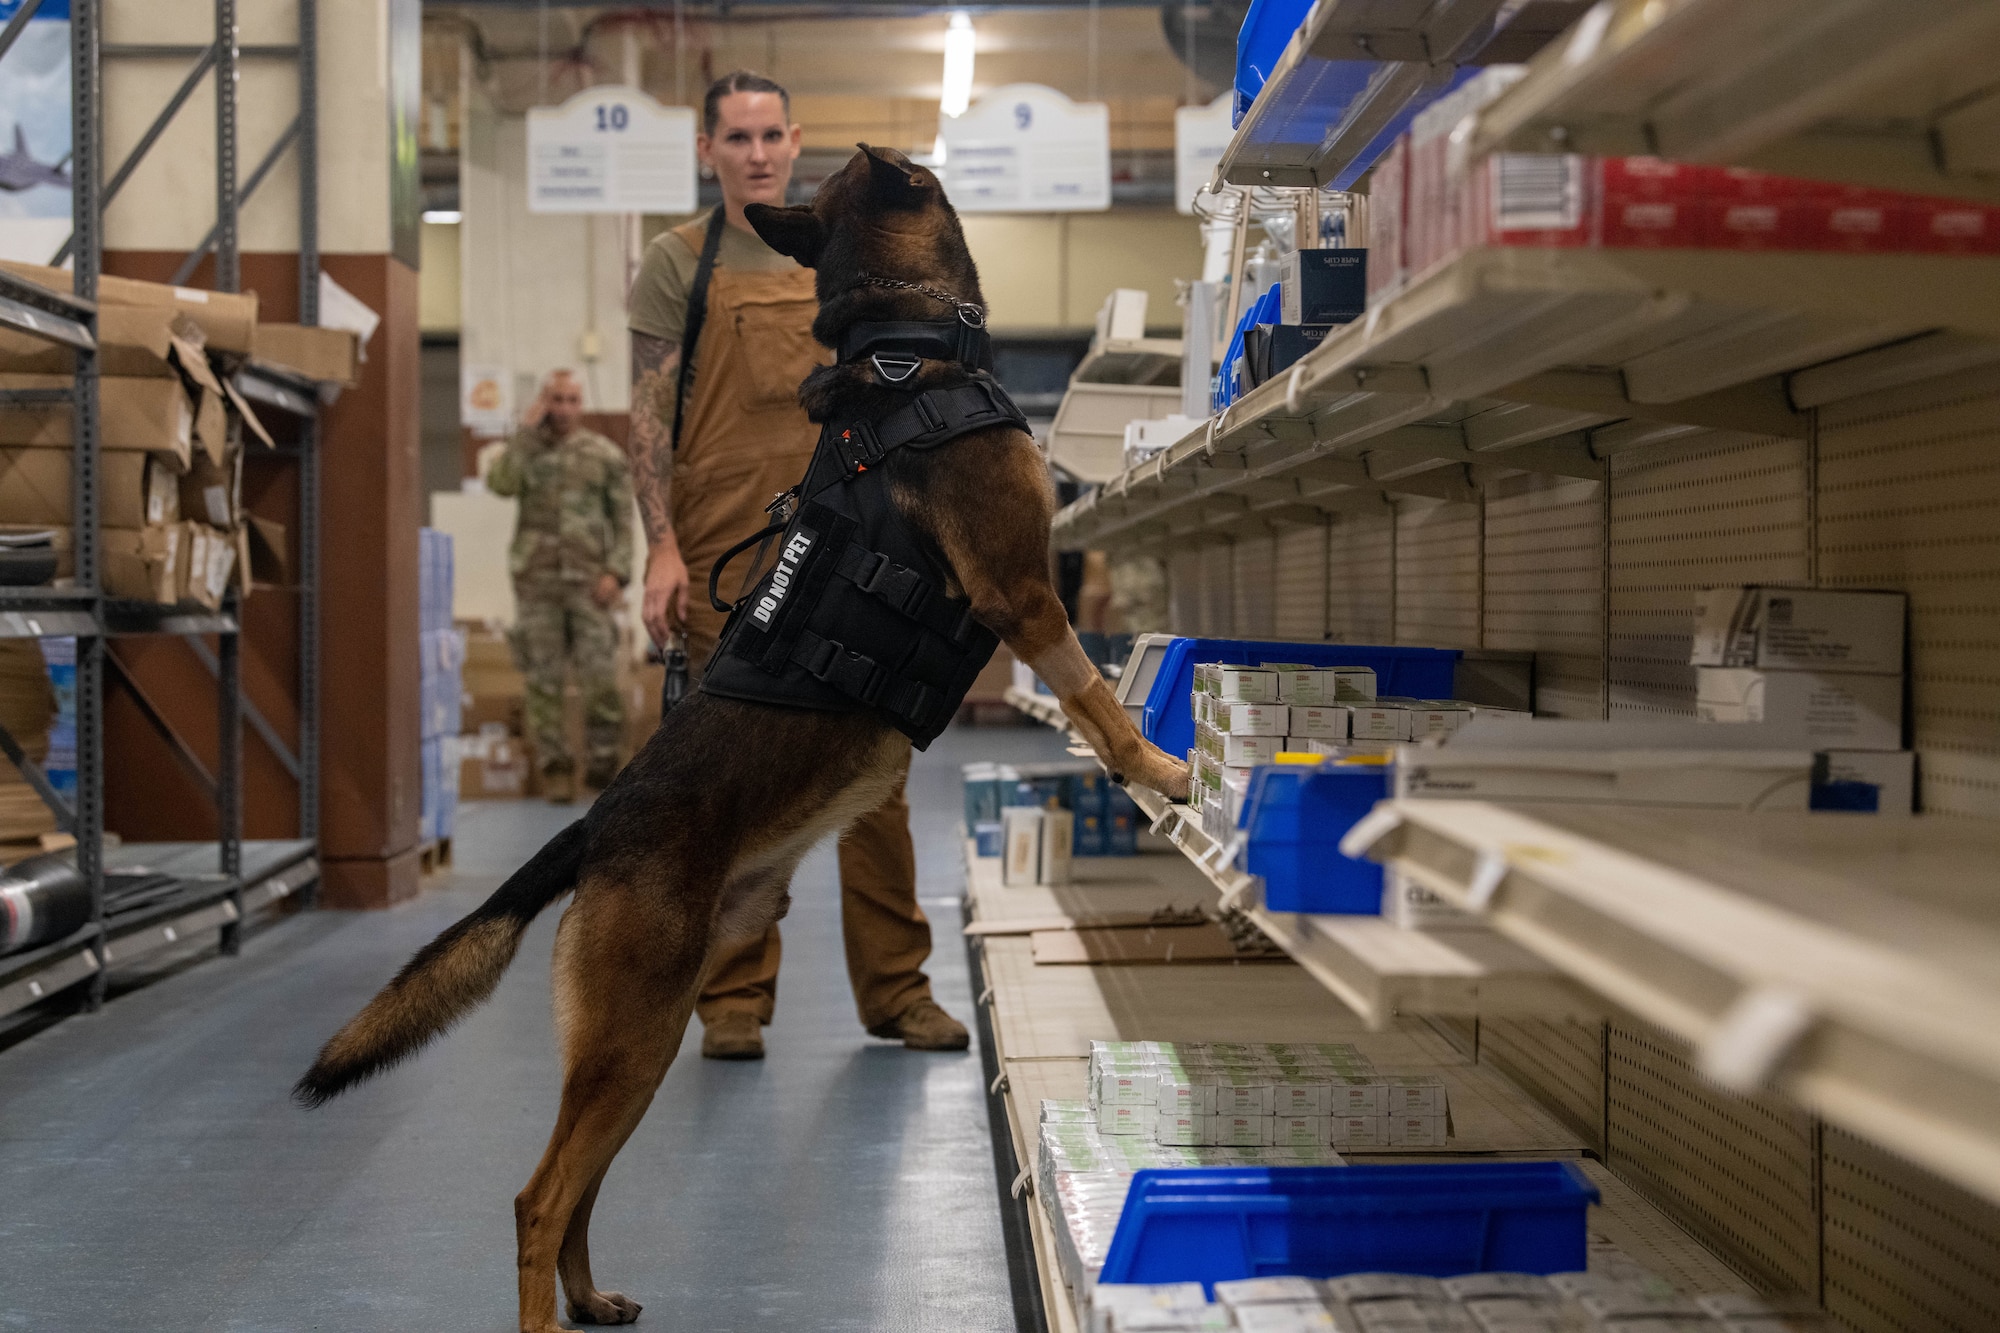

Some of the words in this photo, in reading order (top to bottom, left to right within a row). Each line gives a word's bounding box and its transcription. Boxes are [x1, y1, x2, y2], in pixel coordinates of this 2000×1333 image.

[595, 104, 629, 132] 10
[1014, 102, 1033, 131] 9
[753, 596, 777, 624] DO
[768, 561, 794, 599] NOT
[783, 531, 812, 564] PET
